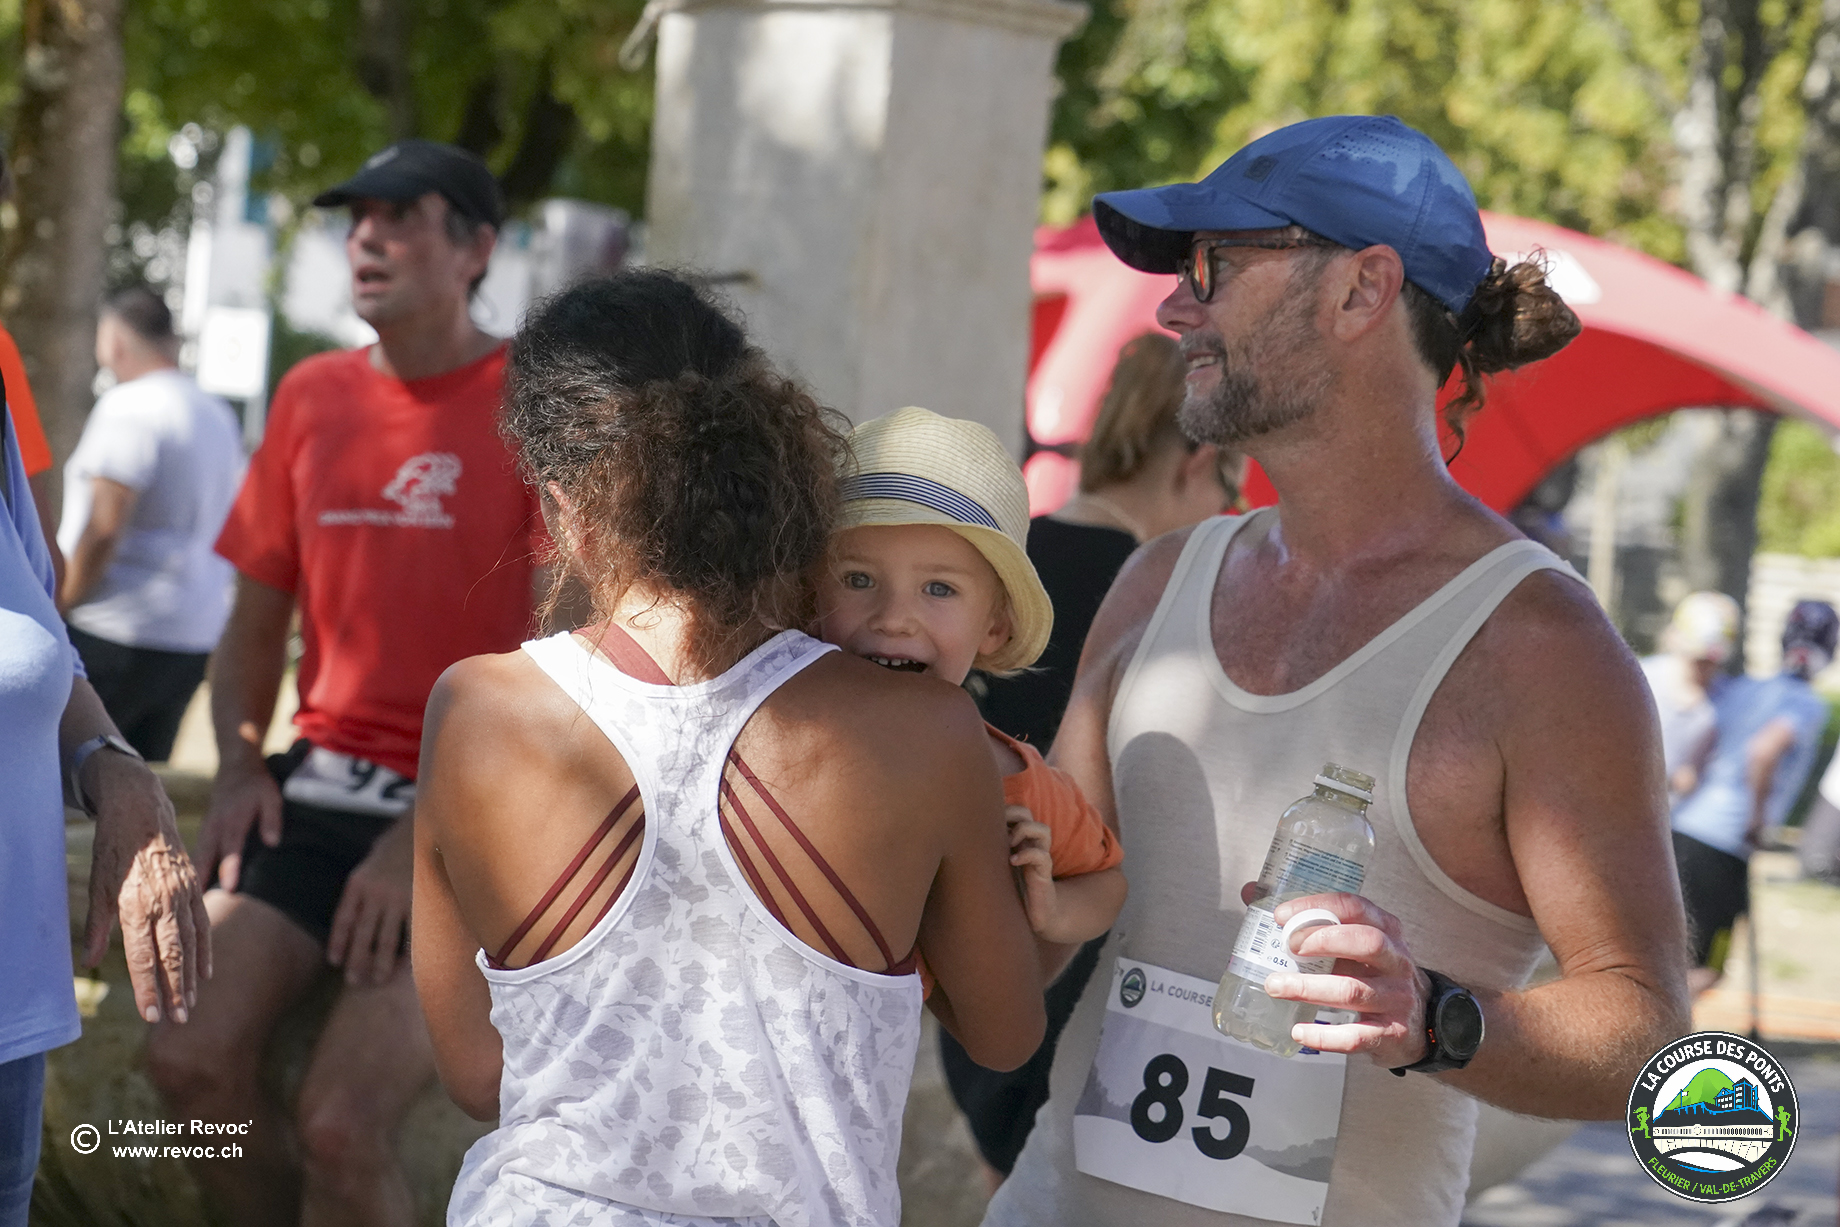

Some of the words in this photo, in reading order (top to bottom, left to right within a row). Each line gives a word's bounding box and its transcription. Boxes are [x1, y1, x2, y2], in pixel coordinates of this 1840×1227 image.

[1150, 980, 1164, 994] LA
[1167, 985, 1213, 1007] COURSE
[1130, 1053, 1256, 1161] 85
